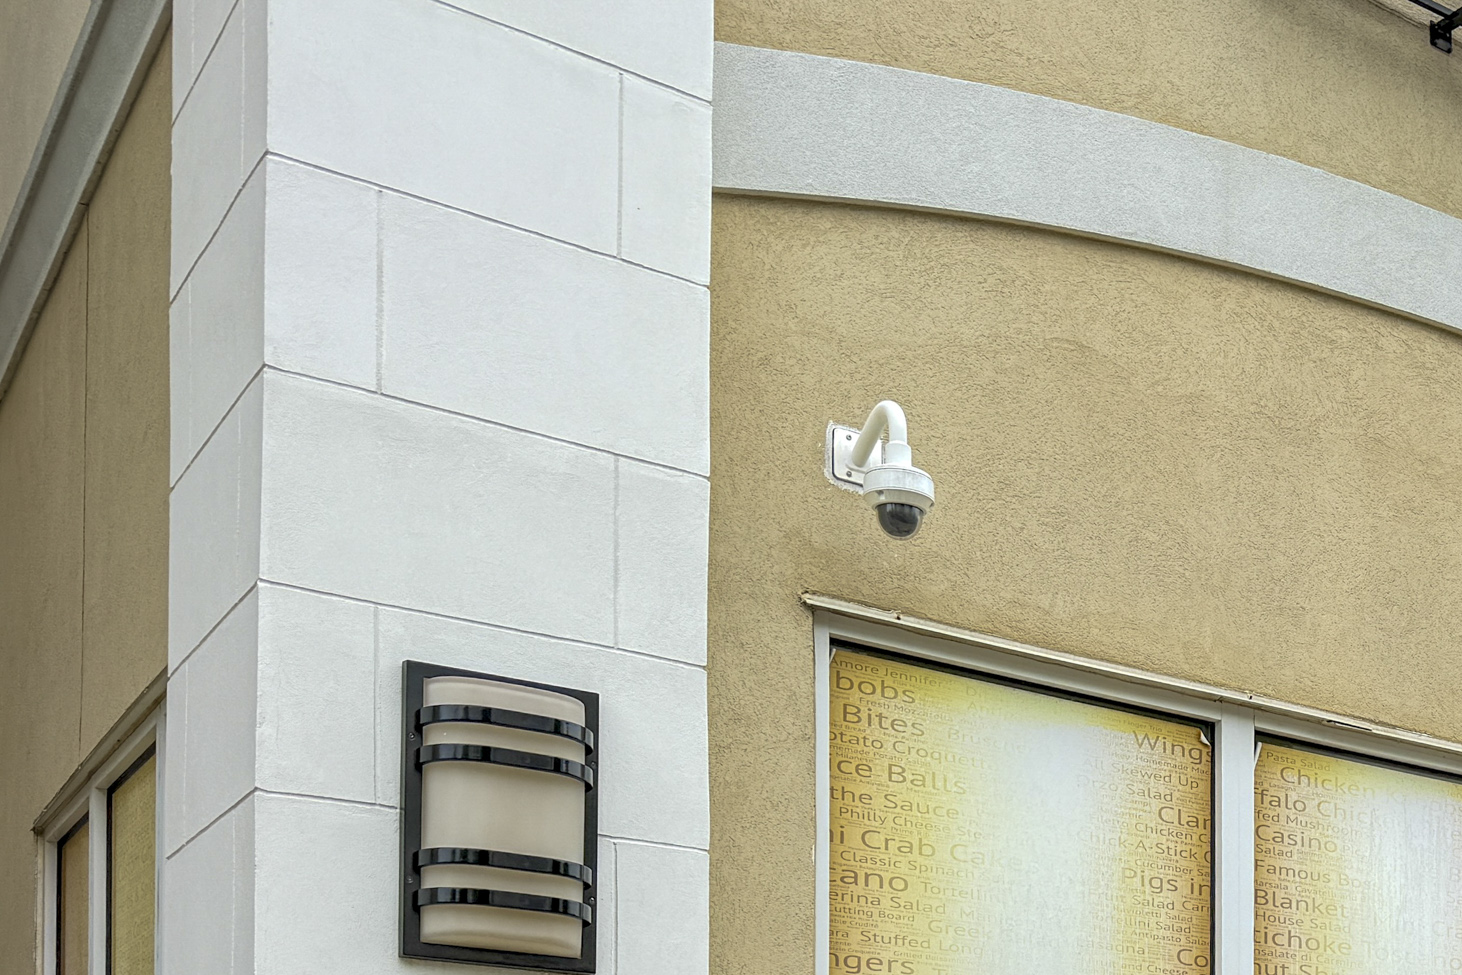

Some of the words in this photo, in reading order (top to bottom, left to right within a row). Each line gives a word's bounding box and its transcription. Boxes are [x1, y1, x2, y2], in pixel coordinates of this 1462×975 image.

[836, 670, 916, 704] bobs
[842, 703, 925, 737] Bites
[1266, 751, 1297, 765] Pasta
[1300, 758, 1332, 772] Salad
[888, 763, 967, 795] Balls
[1111, 763, 1172, 784] Skewed
[1178, 775, 1200, 790] Up
[1125, 783, 1174, 803] Salad
[883, 793, 960, 820] Sauce
[839, 806, 888, 826] Philly
[892, 815, 952, 834] Cheese
[1134, 822, 1194, 842] Chicken
[1255, 824, 1338, 853] Casino
[861, 829, 936, 858] Crab
[1256, 843, 1294, 859] Salad
[840, 850, 903, 869] Classic
[907, 860, 976, 880] Spinach
[1135, 858, 1194, 875] Cucumber
[1254, 859, 1332, 884] Famous
[1121, 867, 1179, 895] Pigs
[890, 896, 946, 915] Salad
[1131, 895, 1176, 911] Salad
[1255, 888, 1349, 919] Blanket
[878, 910, 915, 923] Board
[1165, 911, 1193, 923] Salad
[1255, 911, 1305, 927] House
[1131, 930, 1182, 945] Antipasto
[1155, 921, 1192, 934] Salad
[860, 930, 932, 950] Stuffed
